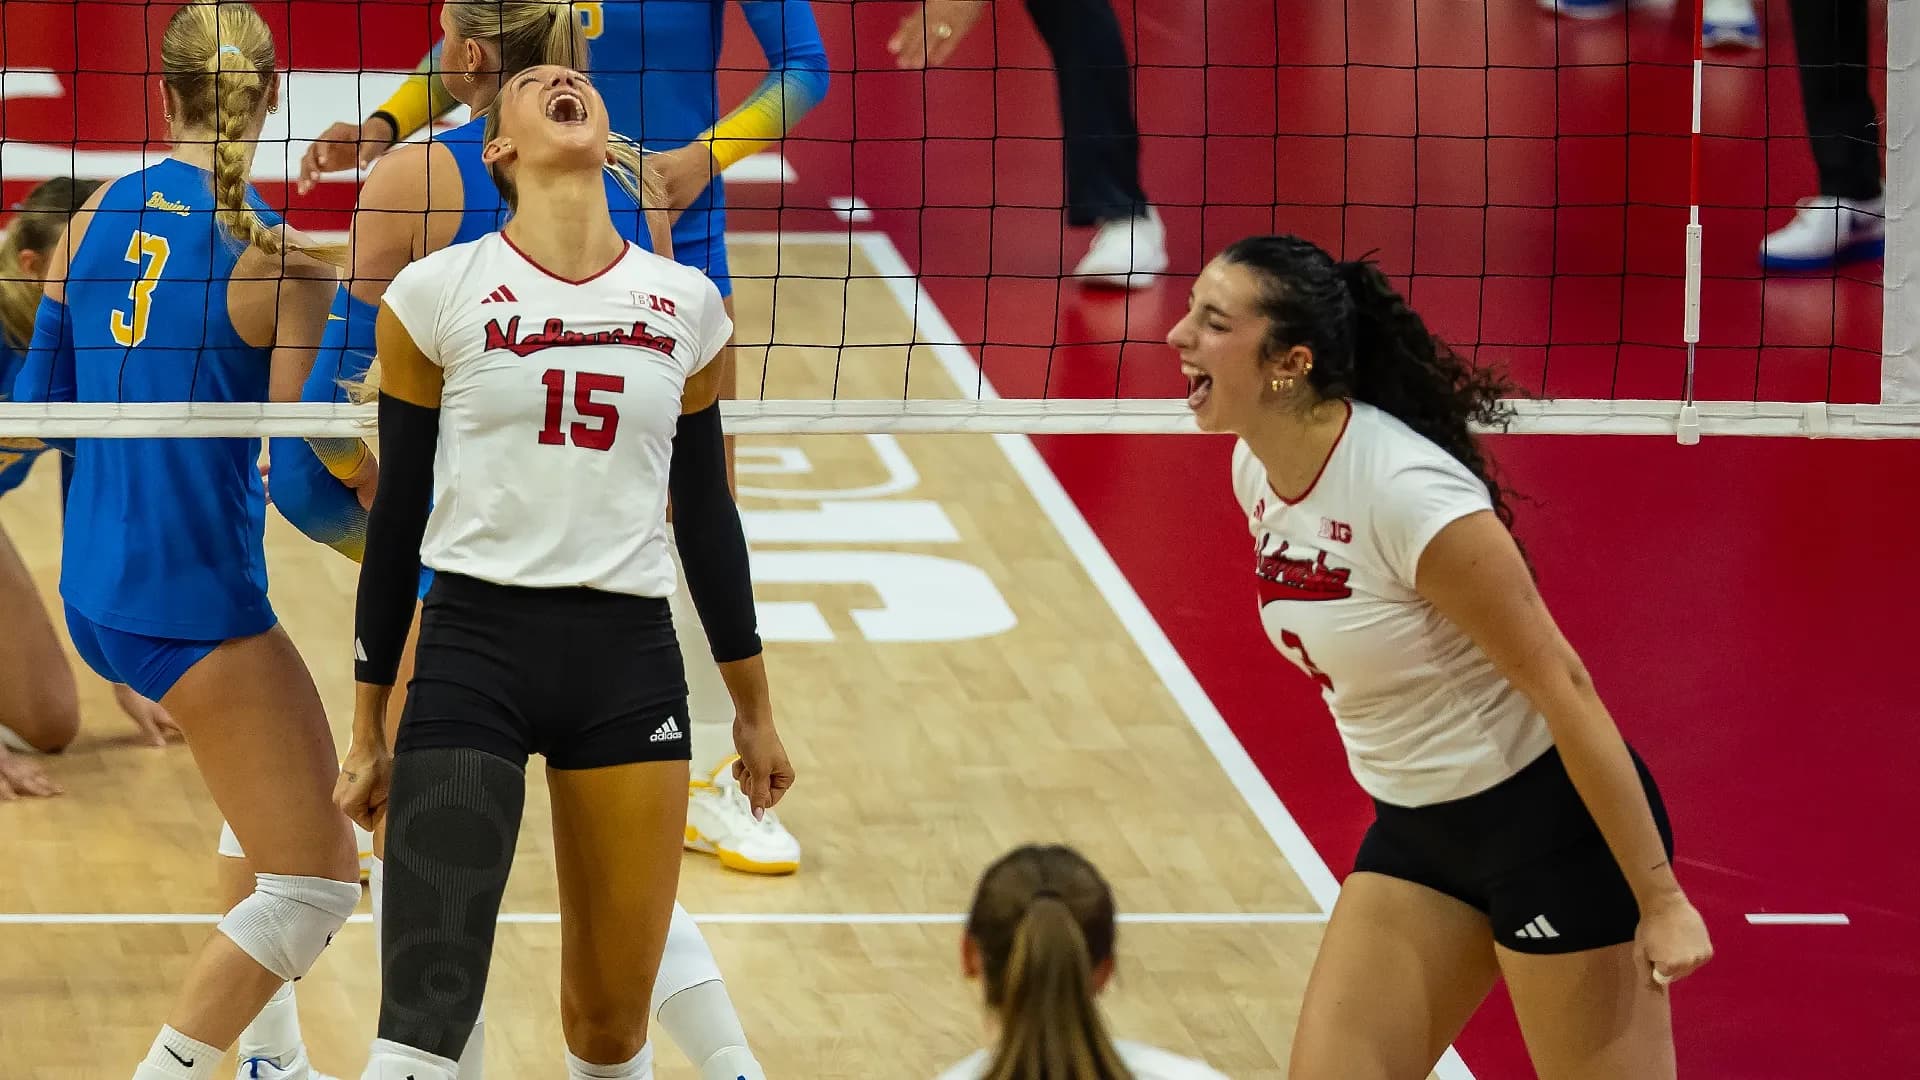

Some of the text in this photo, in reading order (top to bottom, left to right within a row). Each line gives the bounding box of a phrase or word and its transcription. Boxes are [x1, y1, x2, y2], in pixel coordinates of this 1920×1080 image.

[146, 191, 191, 216] Bruins
[110, 230, 170, 347] 3
[484, 315, 677, 358] Nebraska
[538, 369, 624, 451] 15
[649, 731, 683, 742] adidas
